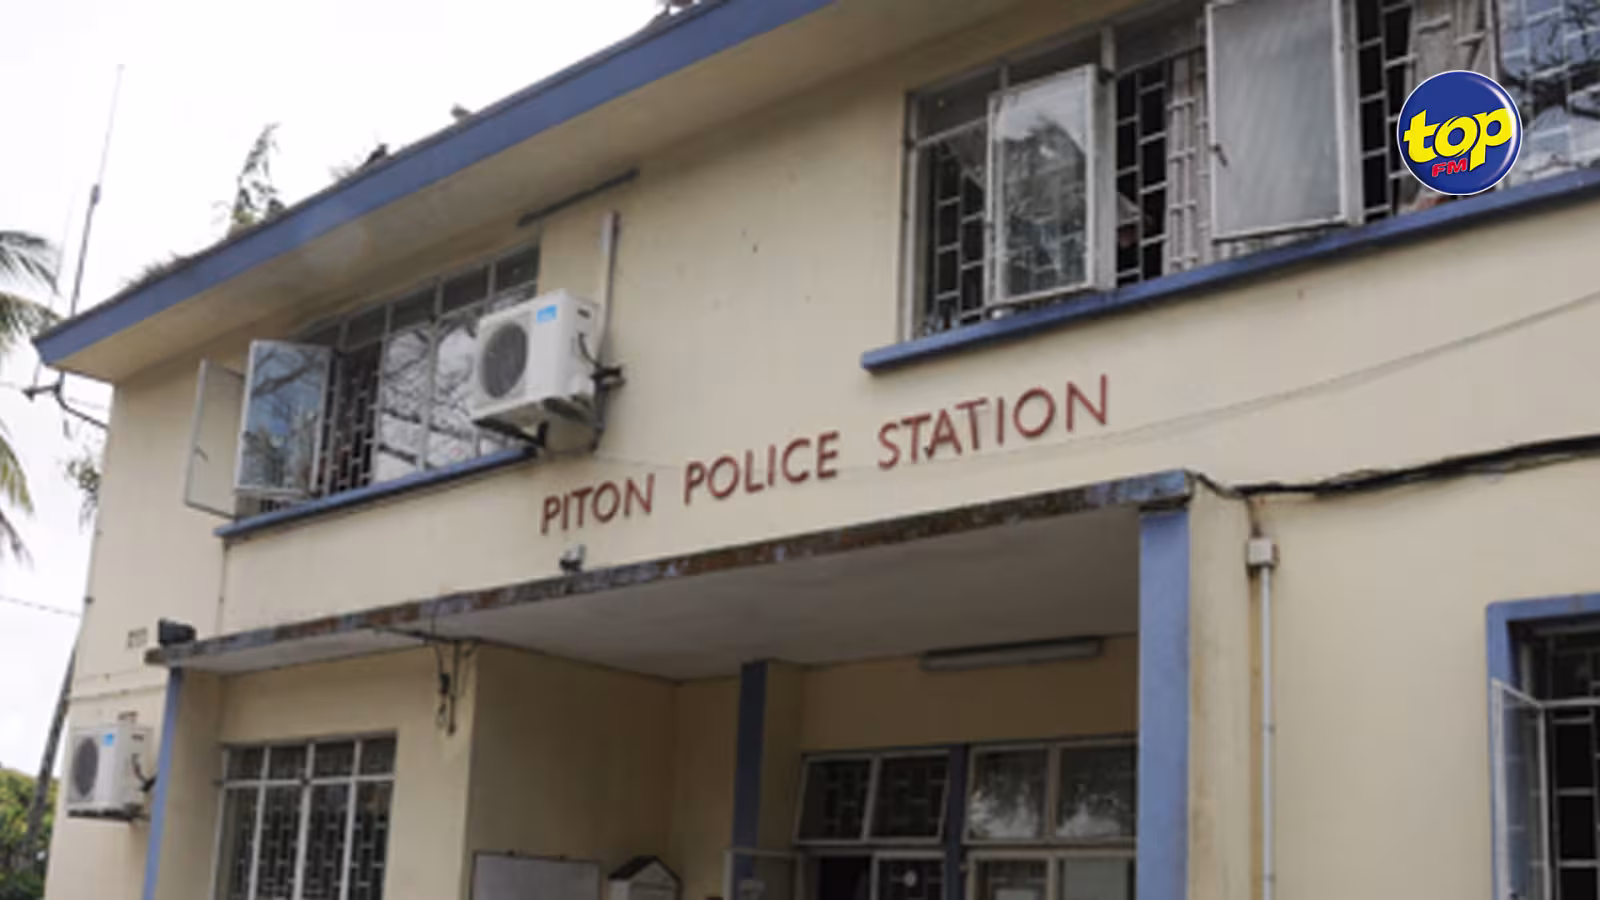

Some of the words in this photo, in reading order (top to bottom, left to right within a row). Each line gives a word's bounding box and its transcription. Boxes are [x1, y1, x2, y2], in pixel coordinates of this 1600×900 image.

[541, 474, 655, 534] PITON
[684, 431, 839, 505] POLICE
[878, 374, 1108, 469] STATION
